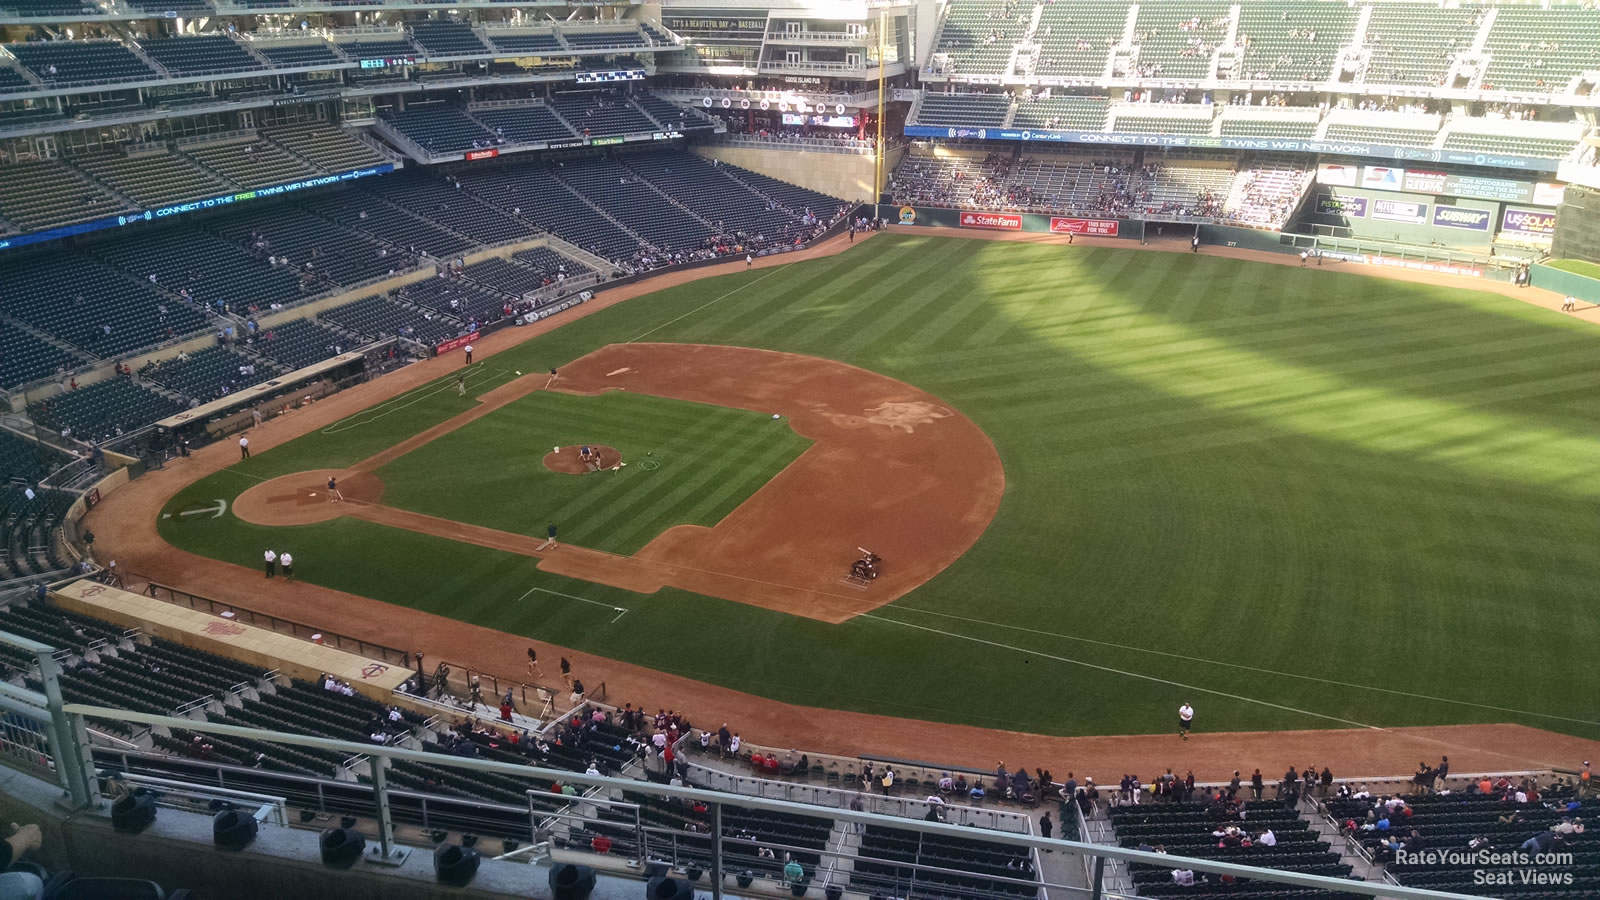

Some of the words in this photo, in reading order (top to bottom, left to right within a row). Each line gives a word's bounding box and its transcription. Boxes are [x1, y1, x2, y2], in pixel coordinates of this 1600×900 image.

[690, 20, 718, 28] BEAUTIFUL
[1080, 134, 1138, 143] CONNECT
[1142, 136, 1158, 144] TO
[1161, 137, 1186, 145] THE
[1189, 138, 1222, 146] FREE
[1225, 139, 1268, 148] TWINS
[1272, 141, 1299, 149] WIFI
[1302, 142, 1370, 154] NETWORK
[1488, 158, 1525, 166] CenturyLink
[1447, 182, 1480, 190] POSTGAME
[1475, 179, 1517, 187] AUTOGRAPHS
[156, 203, 199, 217] CONNECT
[216, 196, 233, 204] THE
[235, 192, 256, 200] FREE
[257, 186, 283, 196] TWINS
[284, 184, 302, 192] WIFI
[302, 175, 339, 188] NETWORK
[1321, 201, 1362, 211] PISTACHIOS
[1436, 210, 1488, 224] SUBWAY
